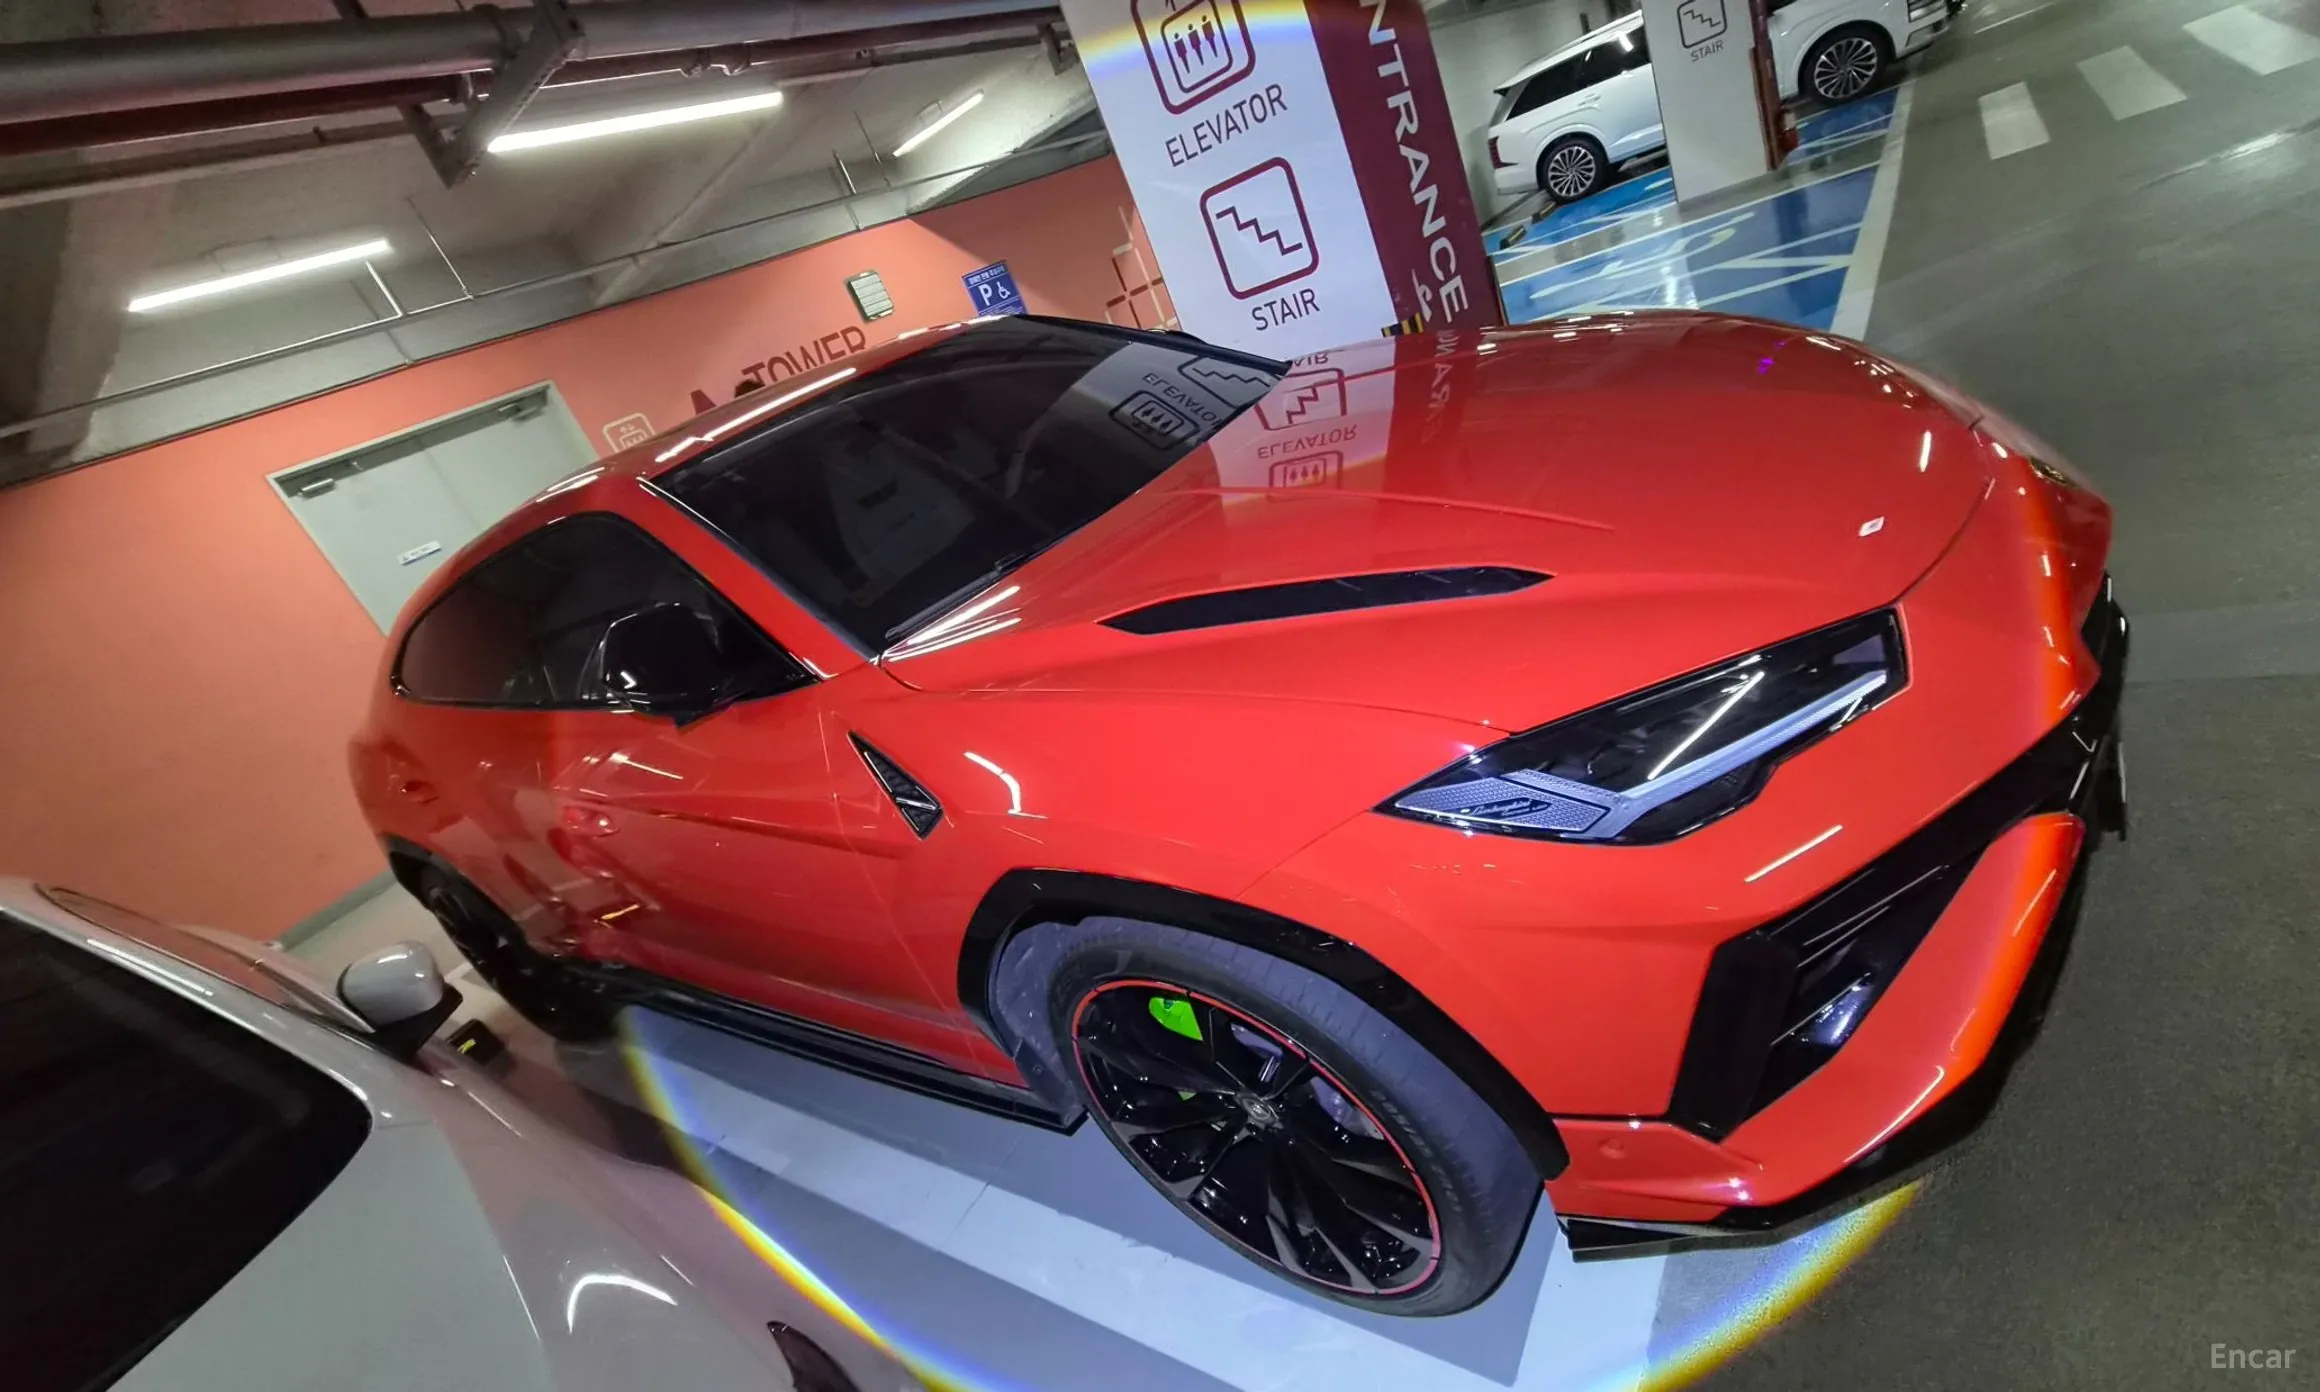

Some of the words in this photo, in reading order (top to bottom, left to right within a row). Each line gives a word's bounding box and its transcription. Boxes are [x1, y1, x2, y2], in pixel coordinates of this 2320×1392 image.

[1691, 40, 1723, 62] STAIR
[1166, 84, 1287, 168] ELEVATOR
[978, 283, 993, 306] P
[1252, 289, 1320, 332] STAIR
